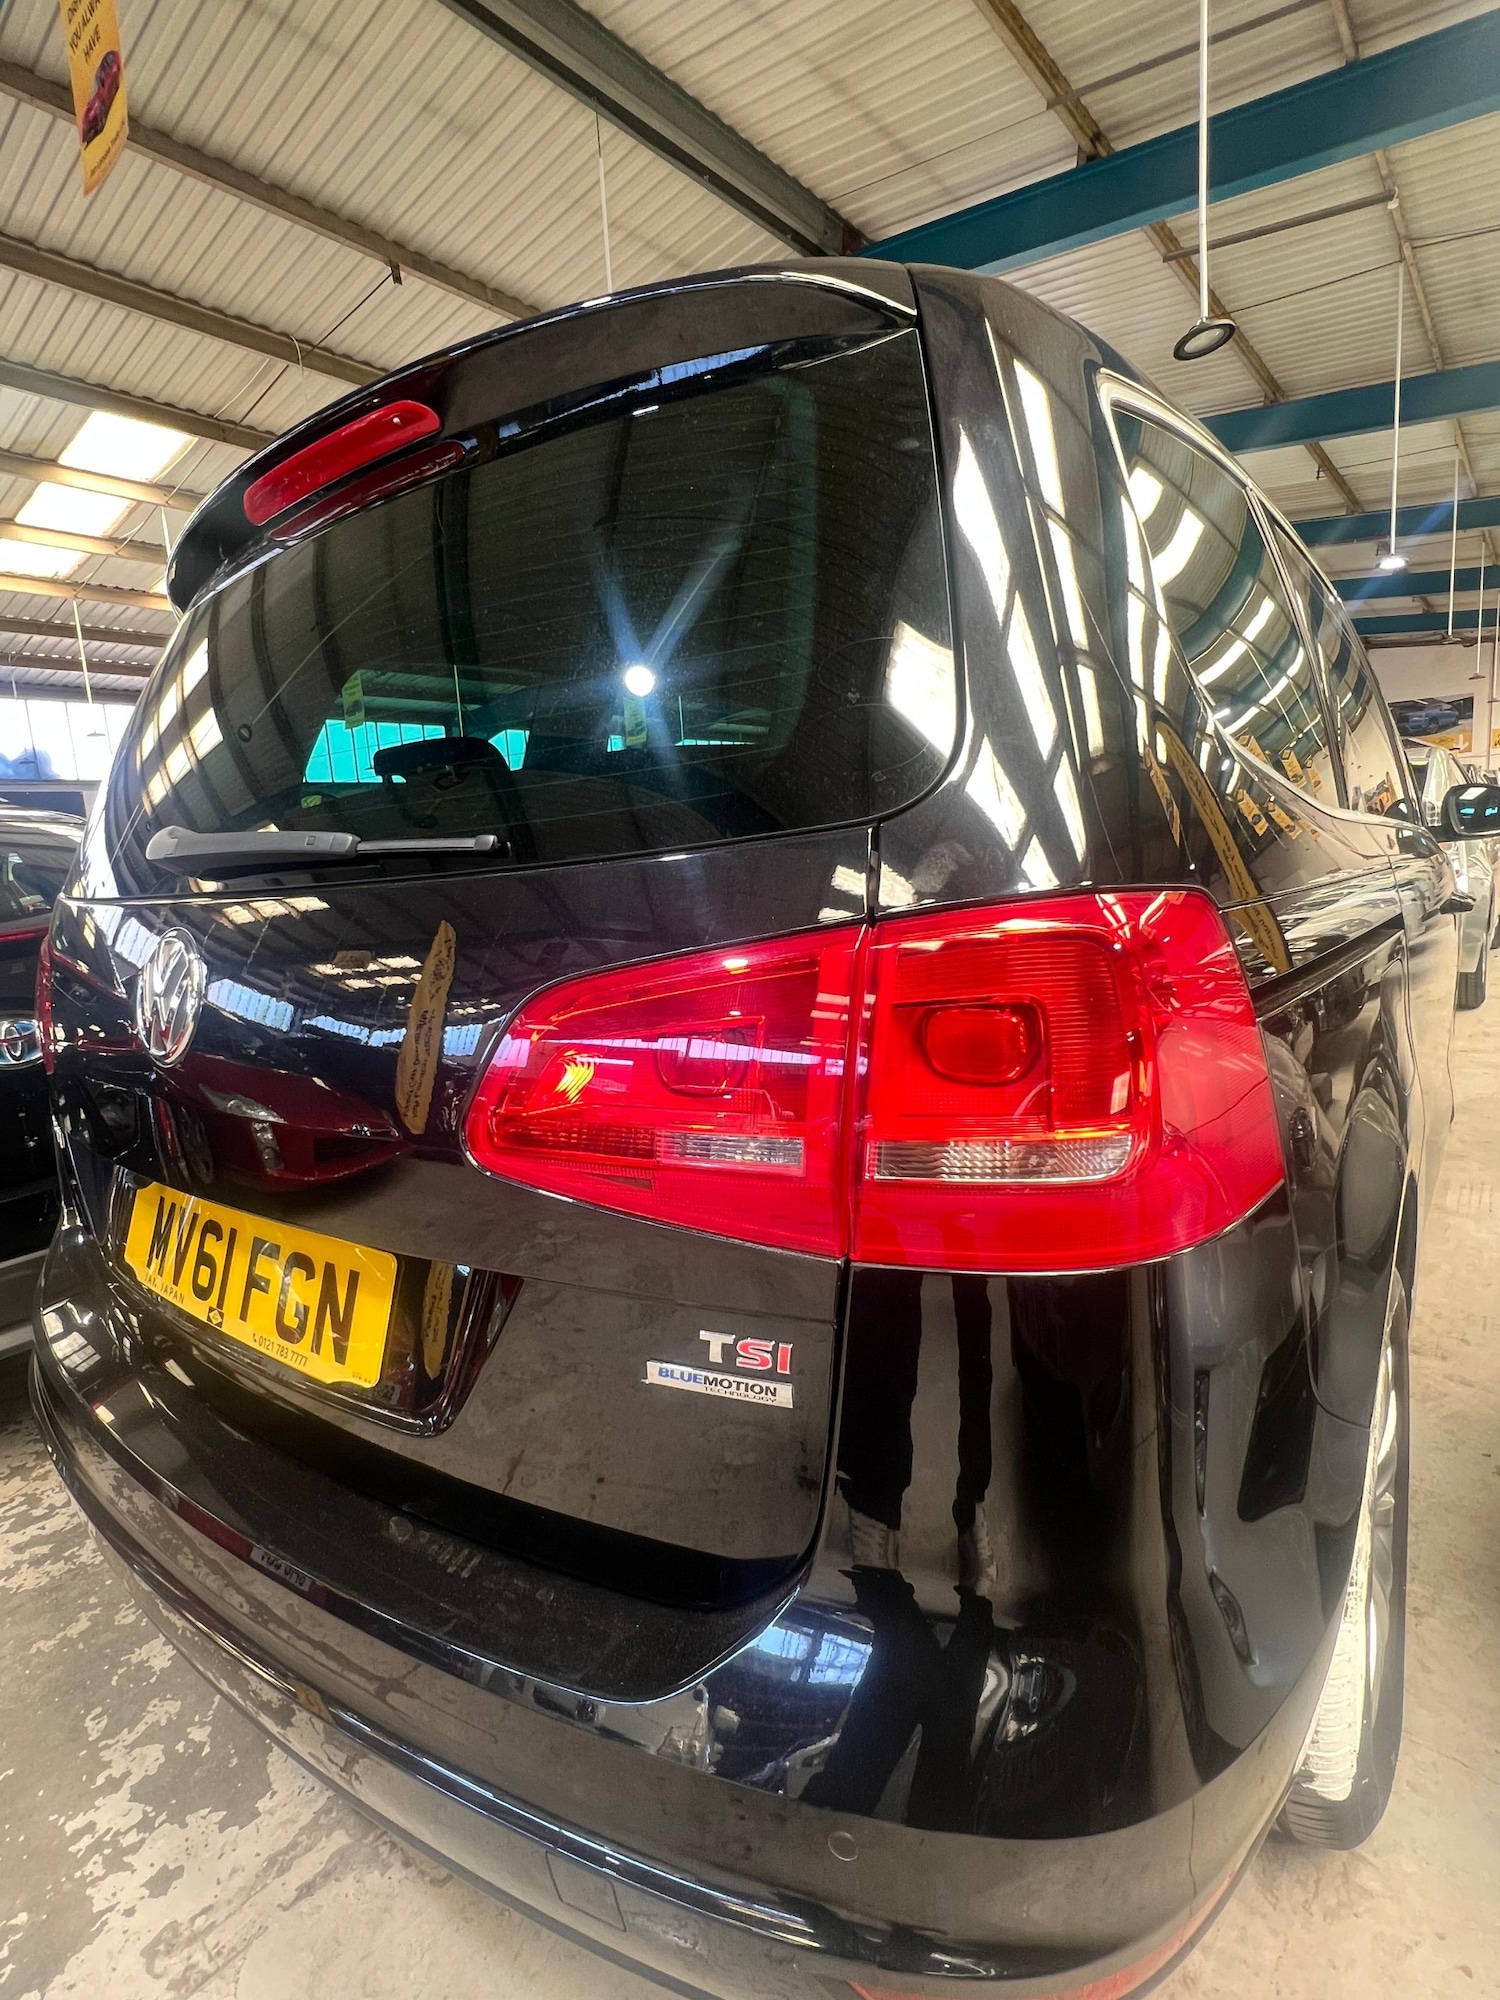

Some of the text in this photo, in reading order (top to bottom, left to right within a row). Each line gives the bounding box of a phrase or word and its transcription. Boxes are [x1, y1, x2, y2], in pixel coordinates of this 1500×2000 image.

[83, 23, 101, 64] HAVE
[146, 1195, 238, 1310] MV61
[238, 1235, 360, 1367] FGN
[160, 1282, 185, 1304] JAPAN
[258, 1335, 308, 1367] 0121 783 7777
[699, 1329, 794, 1375] TSI
[657, 1366, 777, 1398] BLUEMOTION
